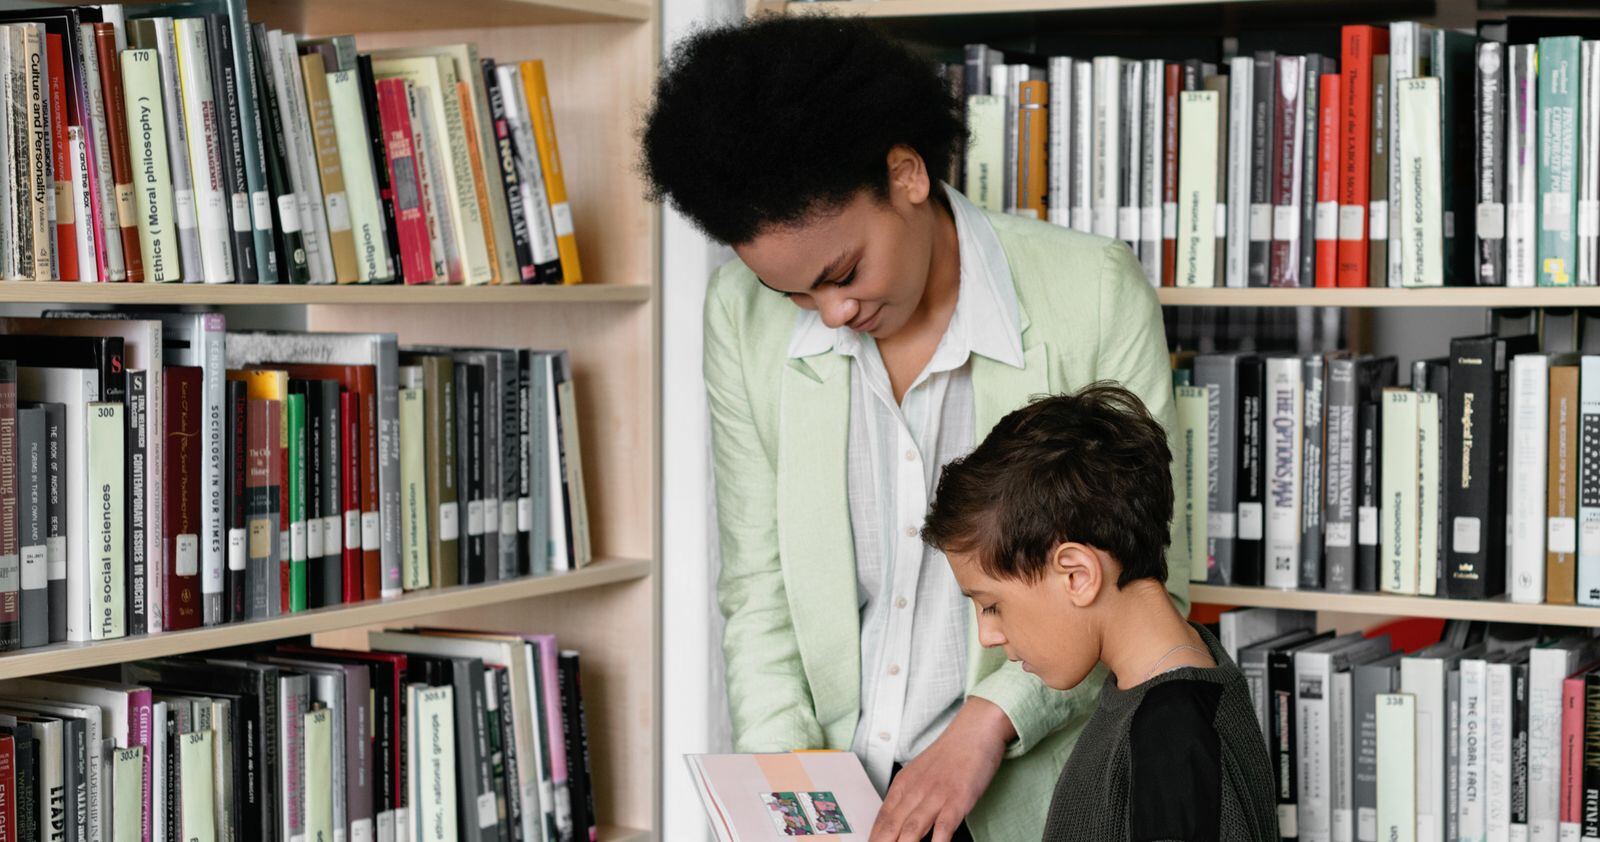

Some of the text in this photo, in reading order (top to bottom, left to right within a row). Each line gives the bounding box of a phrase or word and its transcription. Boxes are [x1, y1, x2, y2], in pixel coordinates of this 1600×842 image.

[133, 52, 149, 61] 170
[225, 67, 234, 106] ETHICS
[31, 53, 45, 204] Culture and Personality
[53, 92, 62, 138] MEASUREMENT
[141, 106, 155, 176] philosophy
[229, 107, 237, 128] FOR
[1551, 106, 1562, 170] CORPORATE
[1561, 107, 1573, 170] FINANCIAL
[44, 131, 52, 177] ILLUSIONS
[202, 101, 218, 191] PUBLIC MANAGEMEN
[232, 129, 243, 166] PUBLIC
[499, 139, 516, 185] NOT
[149, 179, 161, 225] Moral
[1413, 157, 1424, 283] Financial economics
[153, 238, 165, 281] Ethics
[362, 223, 377, 279] Religion
[1187, 190, 1201, 284] Working women
[210, 340, 219, 390] KENDALL
[98, 407, 114, 418] 300
[1207, 383, 1220, 494] INVESTMENTS
[1460, 393, 1474, 488] Ecological Economics
[0, 417, 15, 495] Reimagining
[31, 442, 39, 473] PILGRIMS
[51, 462, 58, 472] OF
[1272, 388, 1295, 509] THE OPTIONS MAN
[1329, 405, 1341, 506] FUTURES MARKETS
[1339, 405, 1354, 520] INSIDE THE FINANCIAL
[32, 474, 38, 482] IN
[211, 404, 220, 553] SOCIOLOGY IN OUR TIMES
[31, 505, 39, 521] OWN
[31, 522, 39, 541] LAND
[133, 453, 144, 615] CONTEMPORARY ISSUES IN SOCIETY
[409, 483, 420, 586] Social interaction
[1392, 491, 1402, 590] Land economics
[102, 484, 113, 637] The social sciences
[120, 749, 139, 761] 303.4
[190, 732, 204, 744] 304
[430, 713, 442, 755] groups
[1467, 696, 1477, 767] THE GLOBAL
[77, 782, 86, 824] VALUES
[90, 755, 99, 837] LEADERSHIP IN
[432, 758, 442, 804] national
[50, 785, 64, 841] LEADE
